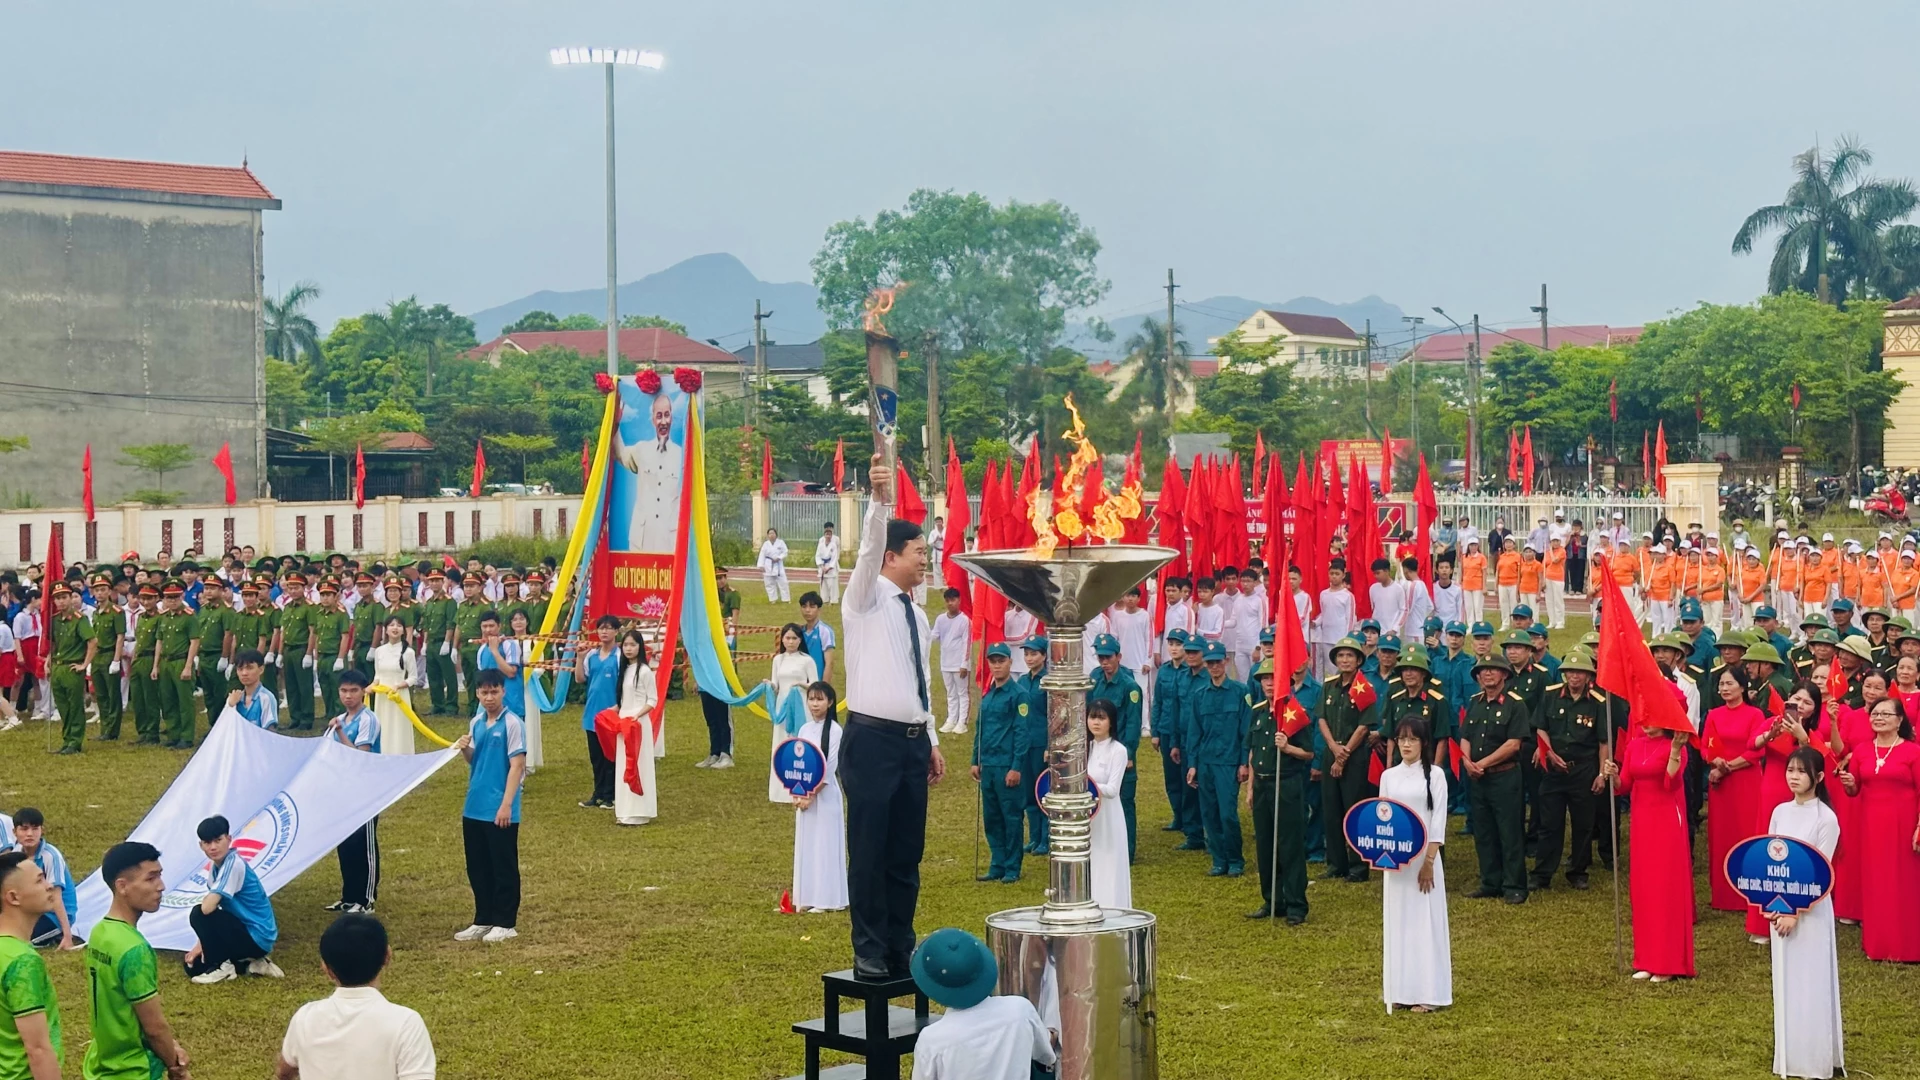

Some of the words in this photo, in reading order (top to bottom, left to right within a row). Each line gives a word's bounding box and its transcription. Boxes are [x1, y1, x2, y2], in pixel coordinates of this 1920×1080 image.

[614, 560, 628, 588] CHỦ
[630, 567, 646, 593] TỊCH
[648, 561, 658, 590] HỒ
[659, 564, 672, 591] CHÍ
[785, 769, 802, 781] QUÂN
[802, 772, 813, 784] SỰ
[1376, 822, 1394, 837] KHỐI
[1357, 835, 1374, 850] HỘI
[1376, 838, 1396, 854] PHỤ
[1398, 840, 1413, 853] NỮ
[1767, 863, 1790, 878] KHỐI
[1800, 883, 1809, 896] LAO
